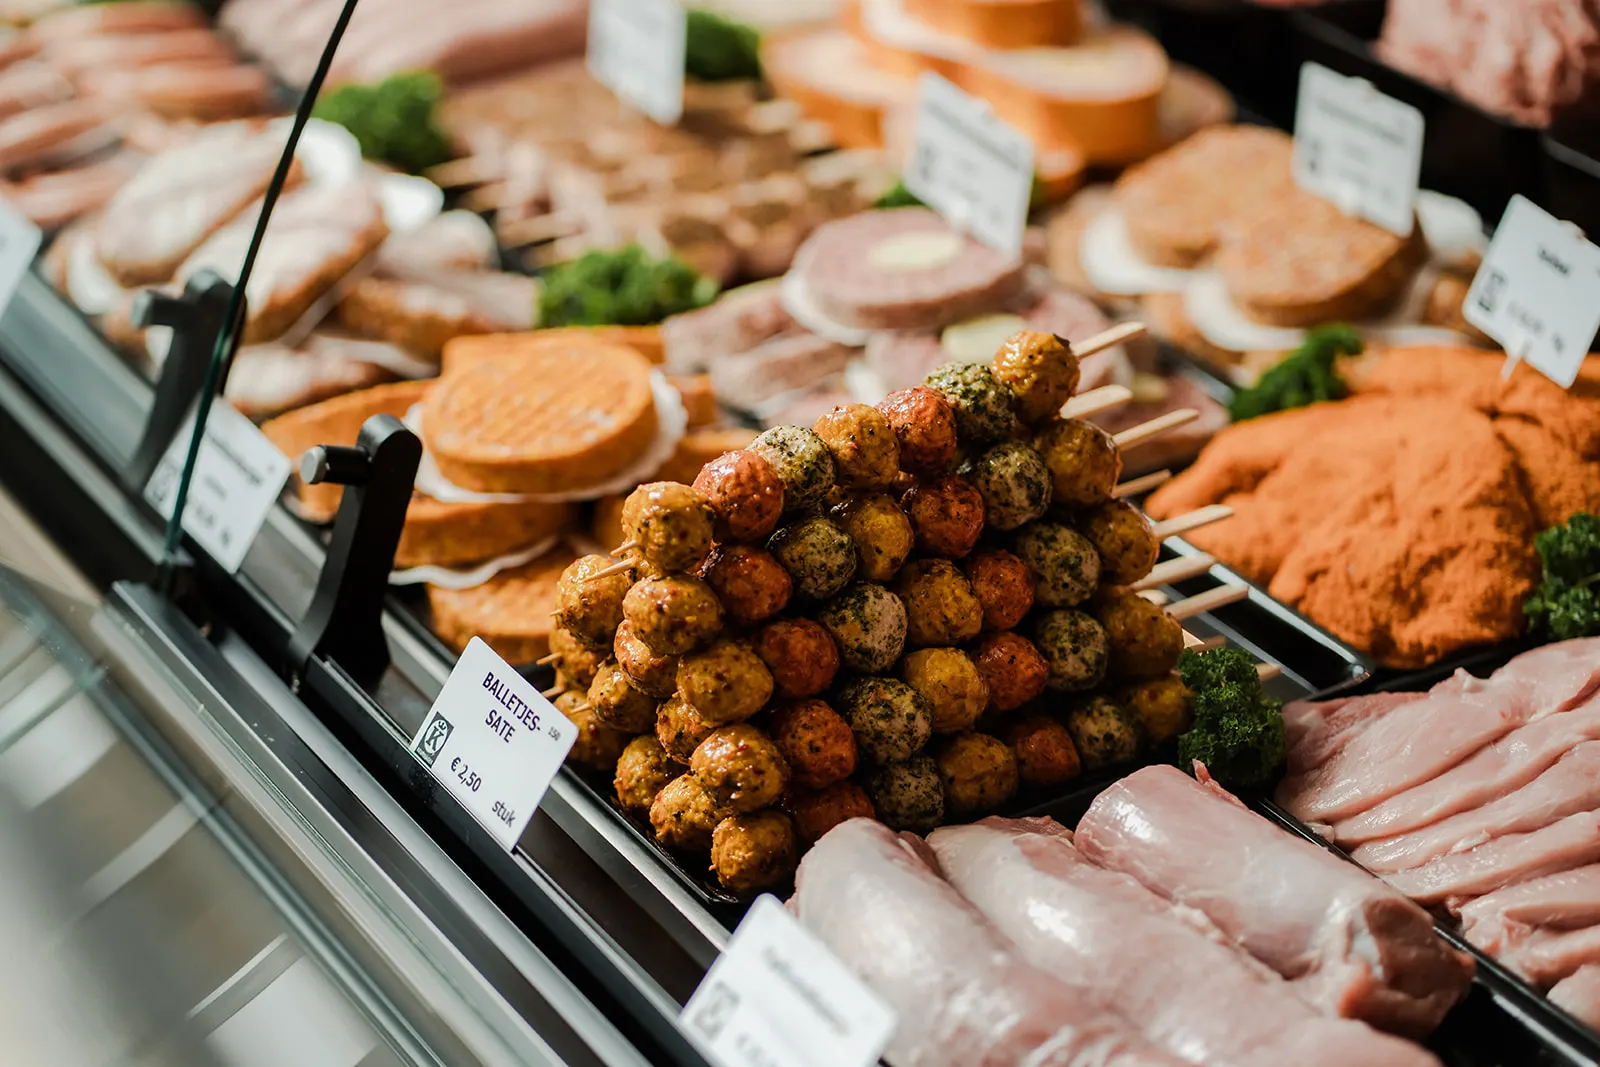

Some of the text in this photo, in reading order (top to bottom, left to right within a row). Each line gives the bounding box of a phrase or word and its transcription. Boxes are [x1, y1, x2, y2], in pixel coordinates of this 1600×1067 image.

[482, 671, 541, 732] BALLETJES-
[485, 709, 516, 743] SATE
[491, 800, 516, 828] stuk
